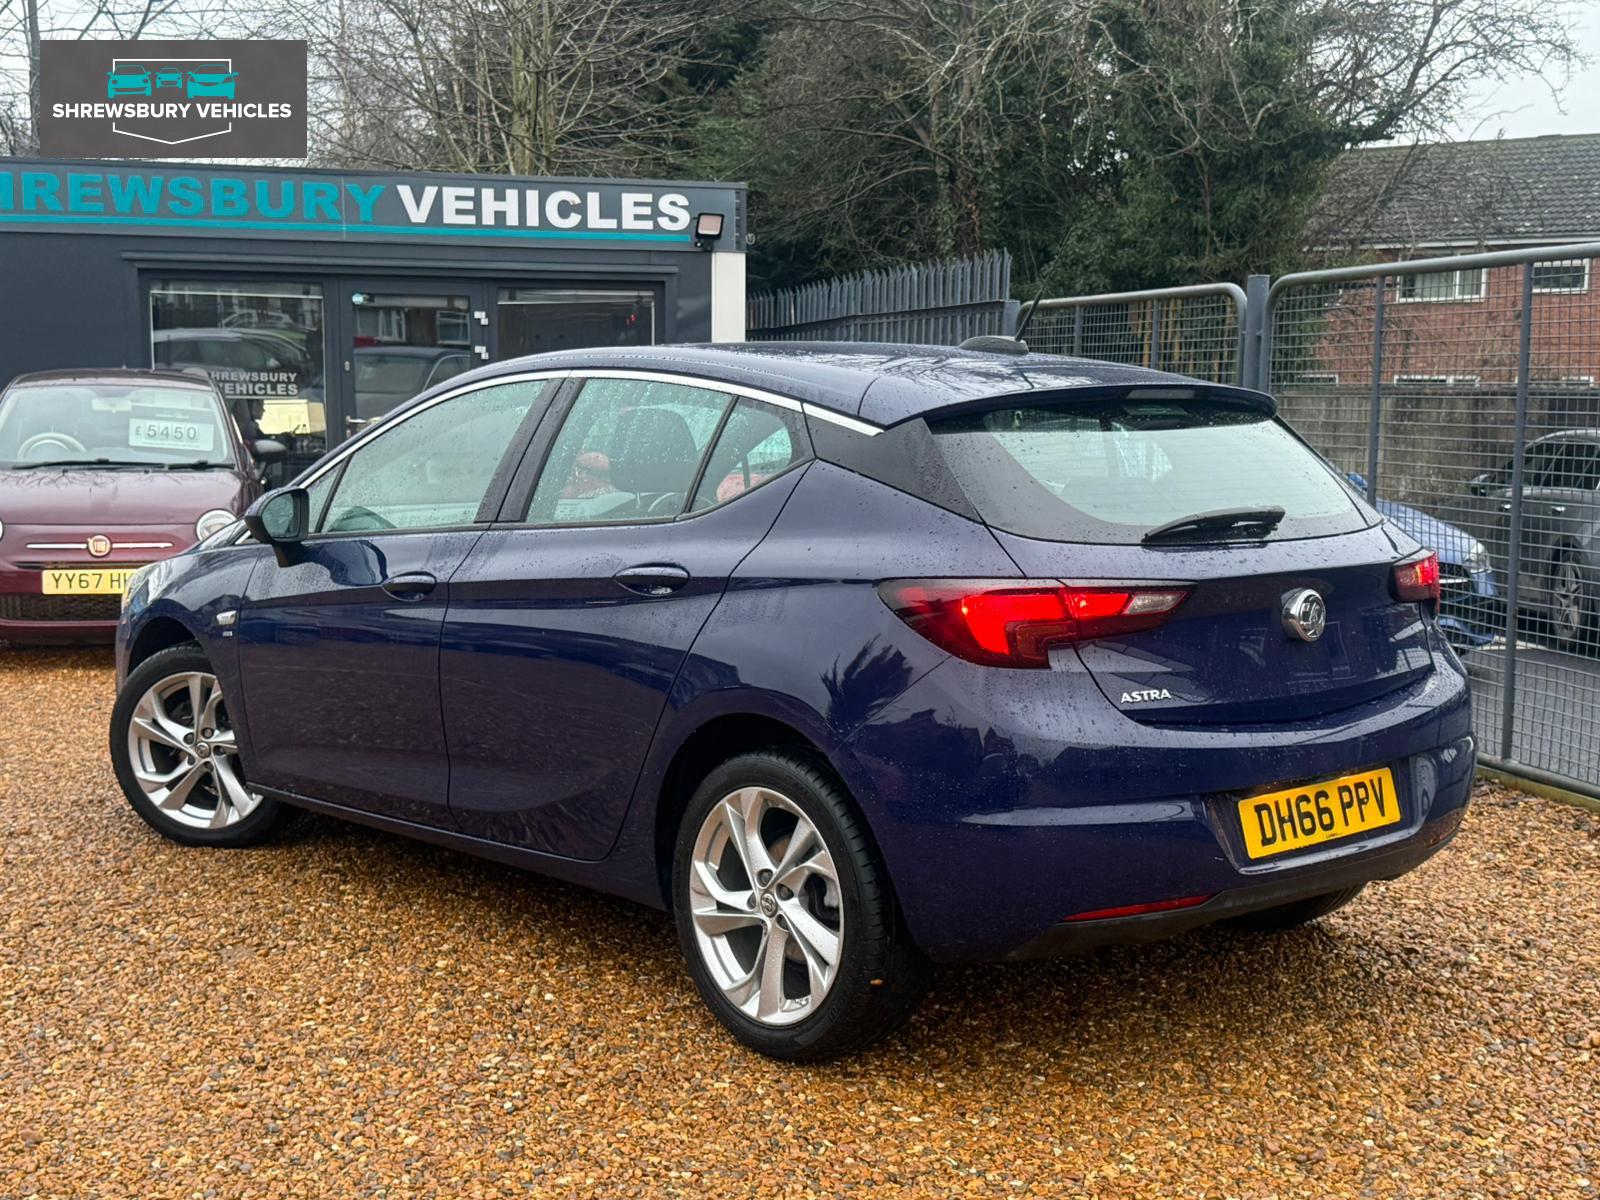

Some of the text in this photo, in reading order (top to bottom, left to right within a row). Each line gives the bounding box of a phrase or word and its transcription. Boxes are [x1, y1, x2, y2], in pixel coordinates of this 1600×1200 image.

[396, 184, 691, 231] VEHICLES
[210, 371, 297, 382] HREWSBURY
[52, 573, 102, 589] YY67
[1120, 688, 1172, 703] ASTRA
[1254, 777, 1386, 847] DH66 PPV
